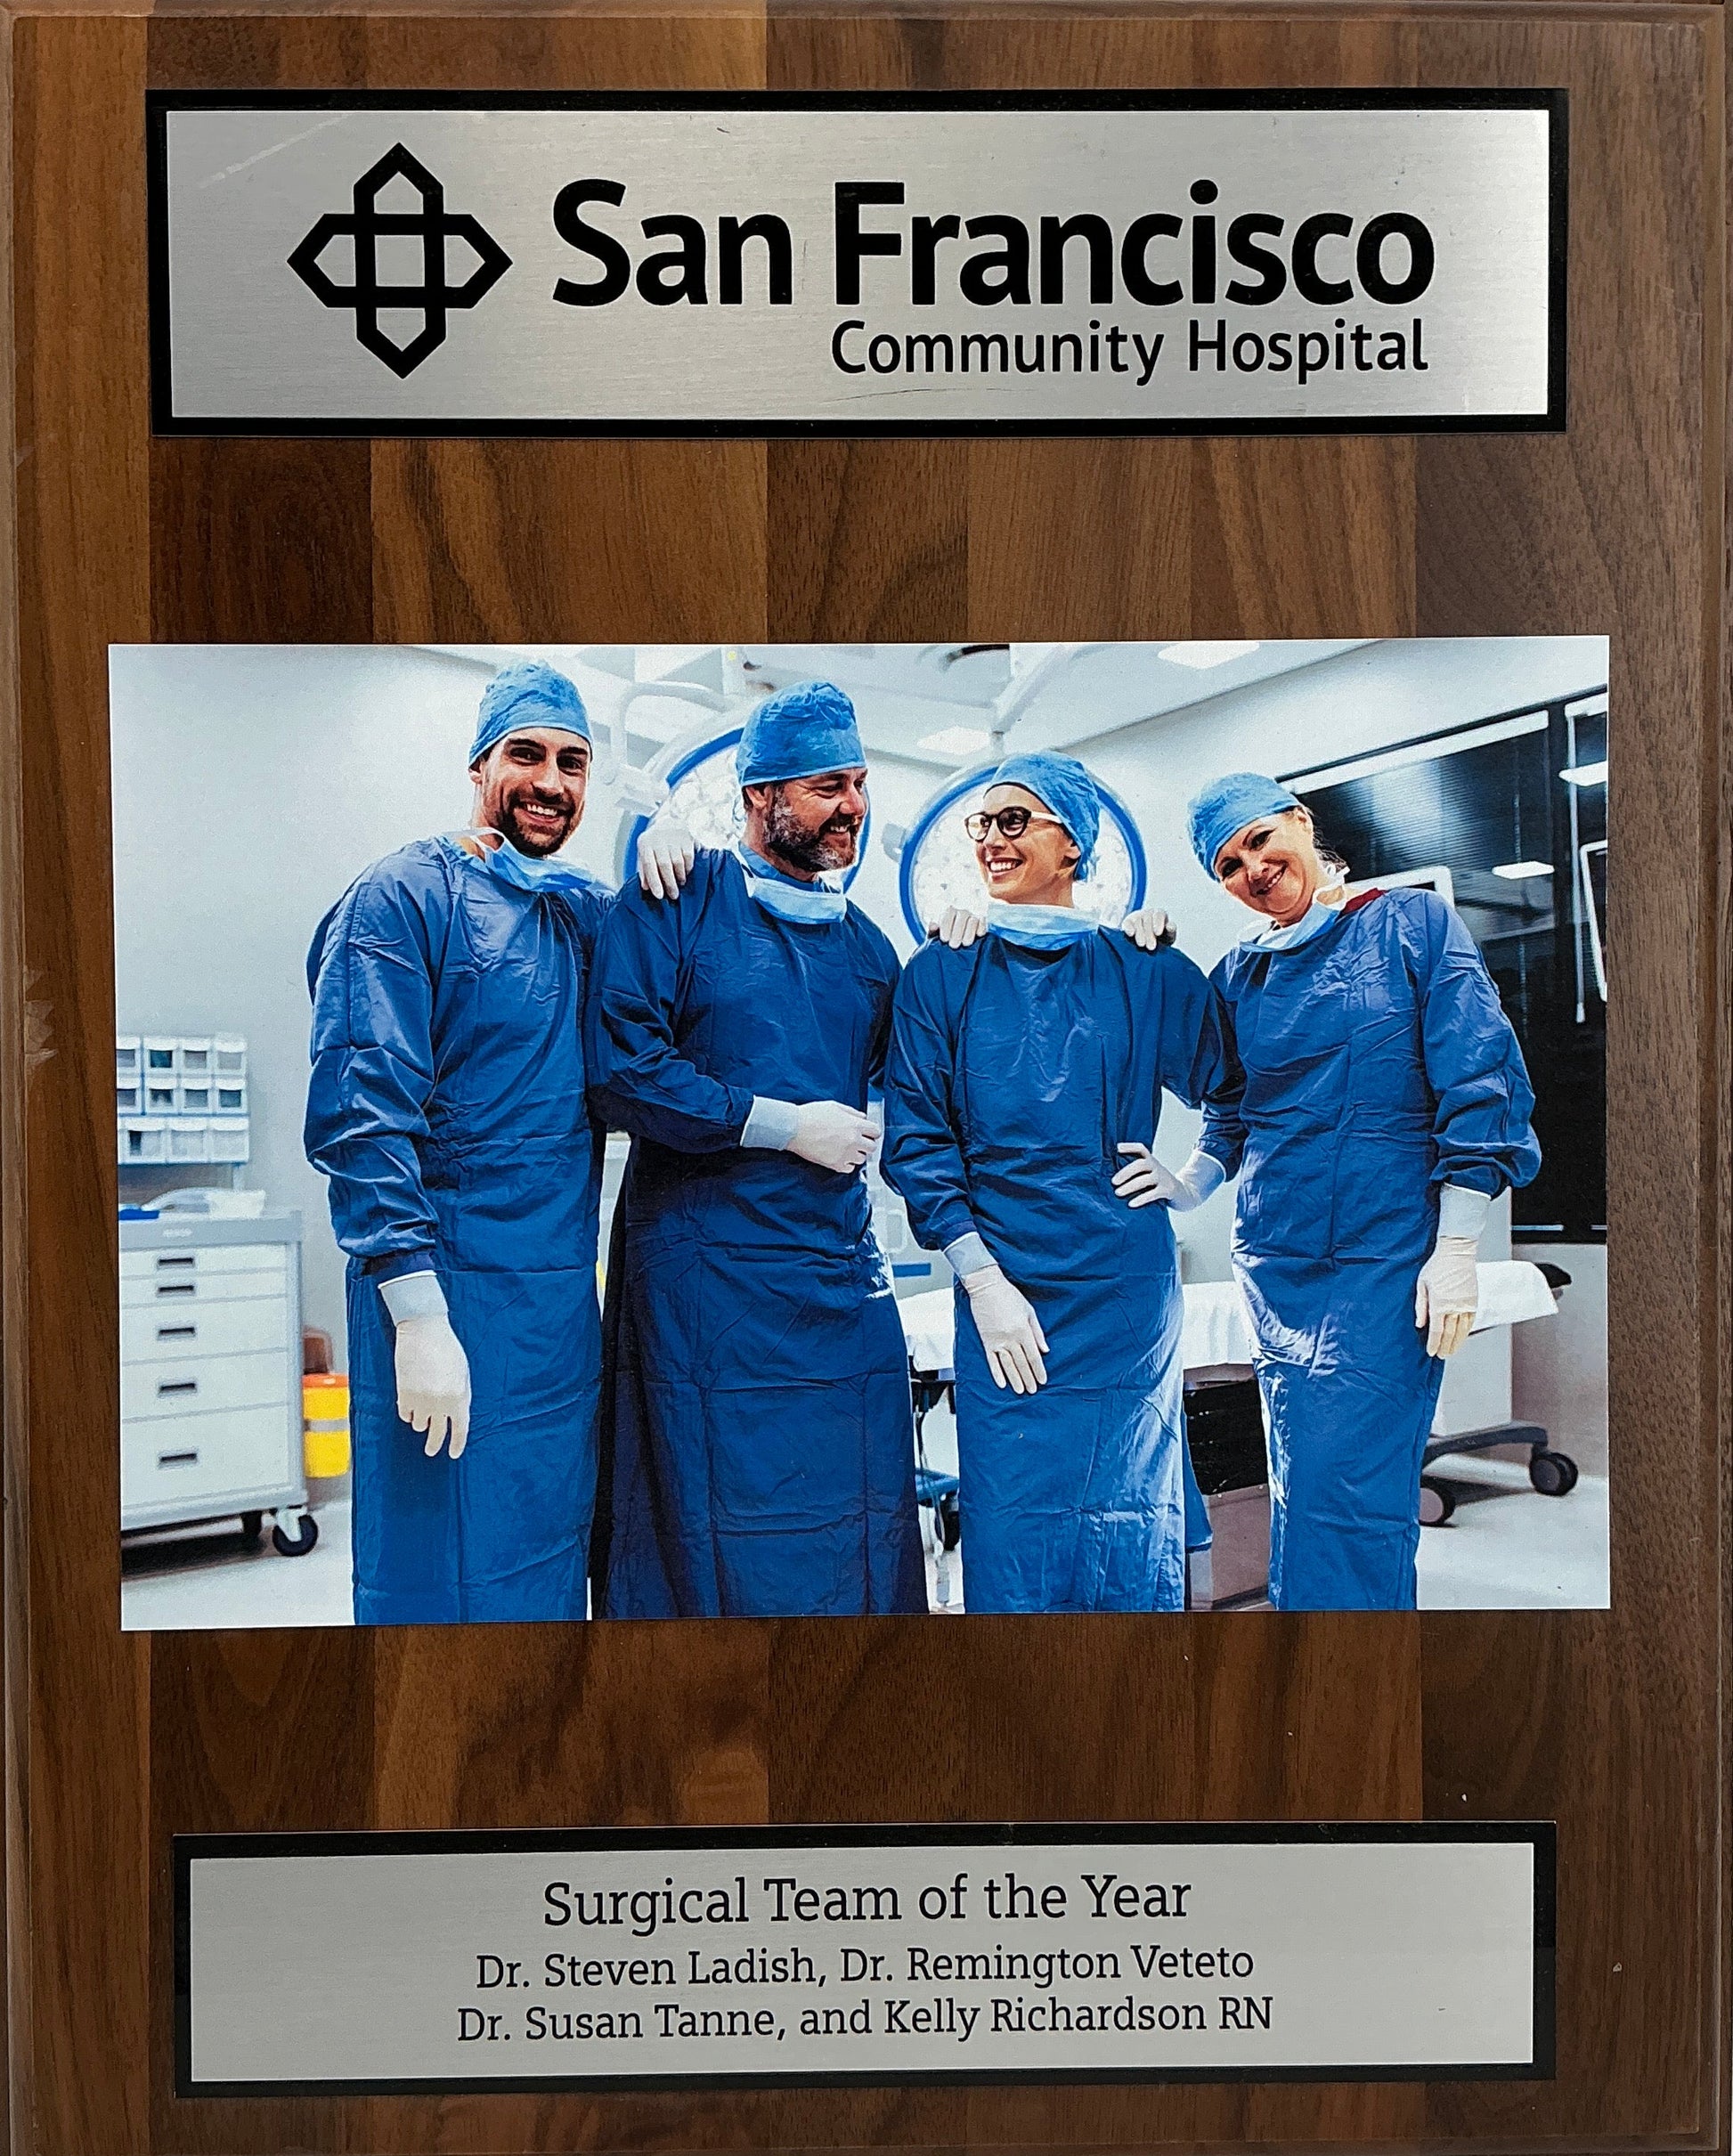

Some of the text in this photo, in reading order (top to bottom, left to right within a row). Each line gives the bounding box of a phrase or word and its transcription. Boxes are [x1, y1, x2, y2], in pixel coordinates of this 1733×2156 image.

[553, 179, 1435, 306] San Francisco
[833, 318, 1428, 386] Community Hospital
[545, 1872, 1192, 1938] Surgical Team of the Year
[476, 1943, 1254, 1989] Dr. Steven Ladish, Dr. Remington Veteto
[458, 1995, 1273, 2043] Dr. Susan Tanne, and Kelly Richardson RN
